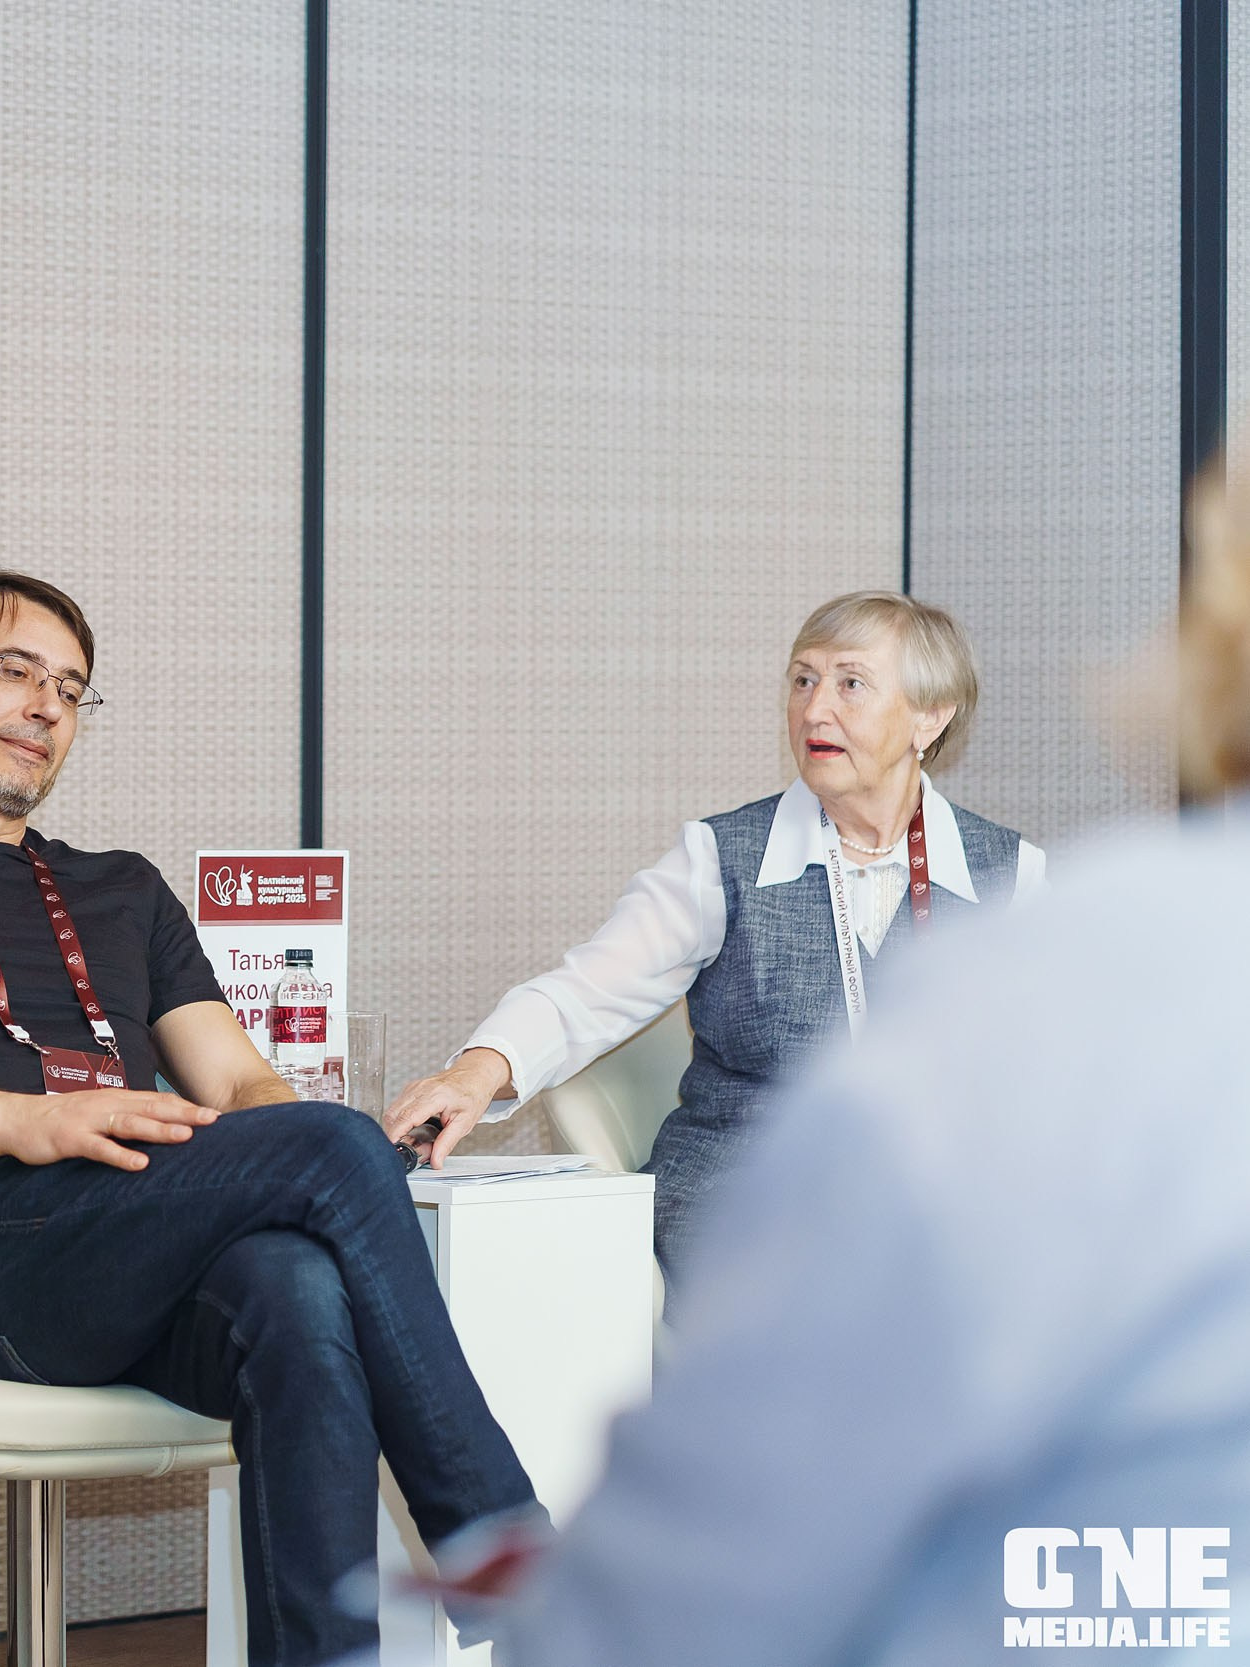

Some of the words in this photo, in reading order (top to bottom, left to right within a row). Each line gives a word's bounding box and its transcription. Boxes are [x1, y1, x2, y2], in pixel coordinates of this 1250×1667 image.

[257, 875, 304, 885] Балтийский
[829, 848, 849, 909] БАЛТИЙСКИЙ
[257, 885, 303, 895] культурный
[257, 895, 284, 905] форум
[285, 894, 306, 903] 2025
[838, 911, 858, 975] КУЛЬТУРНЫЙ
[228, 949, 285, 970] Татья
[848, 976, 862, 1014] ФОРУМ
